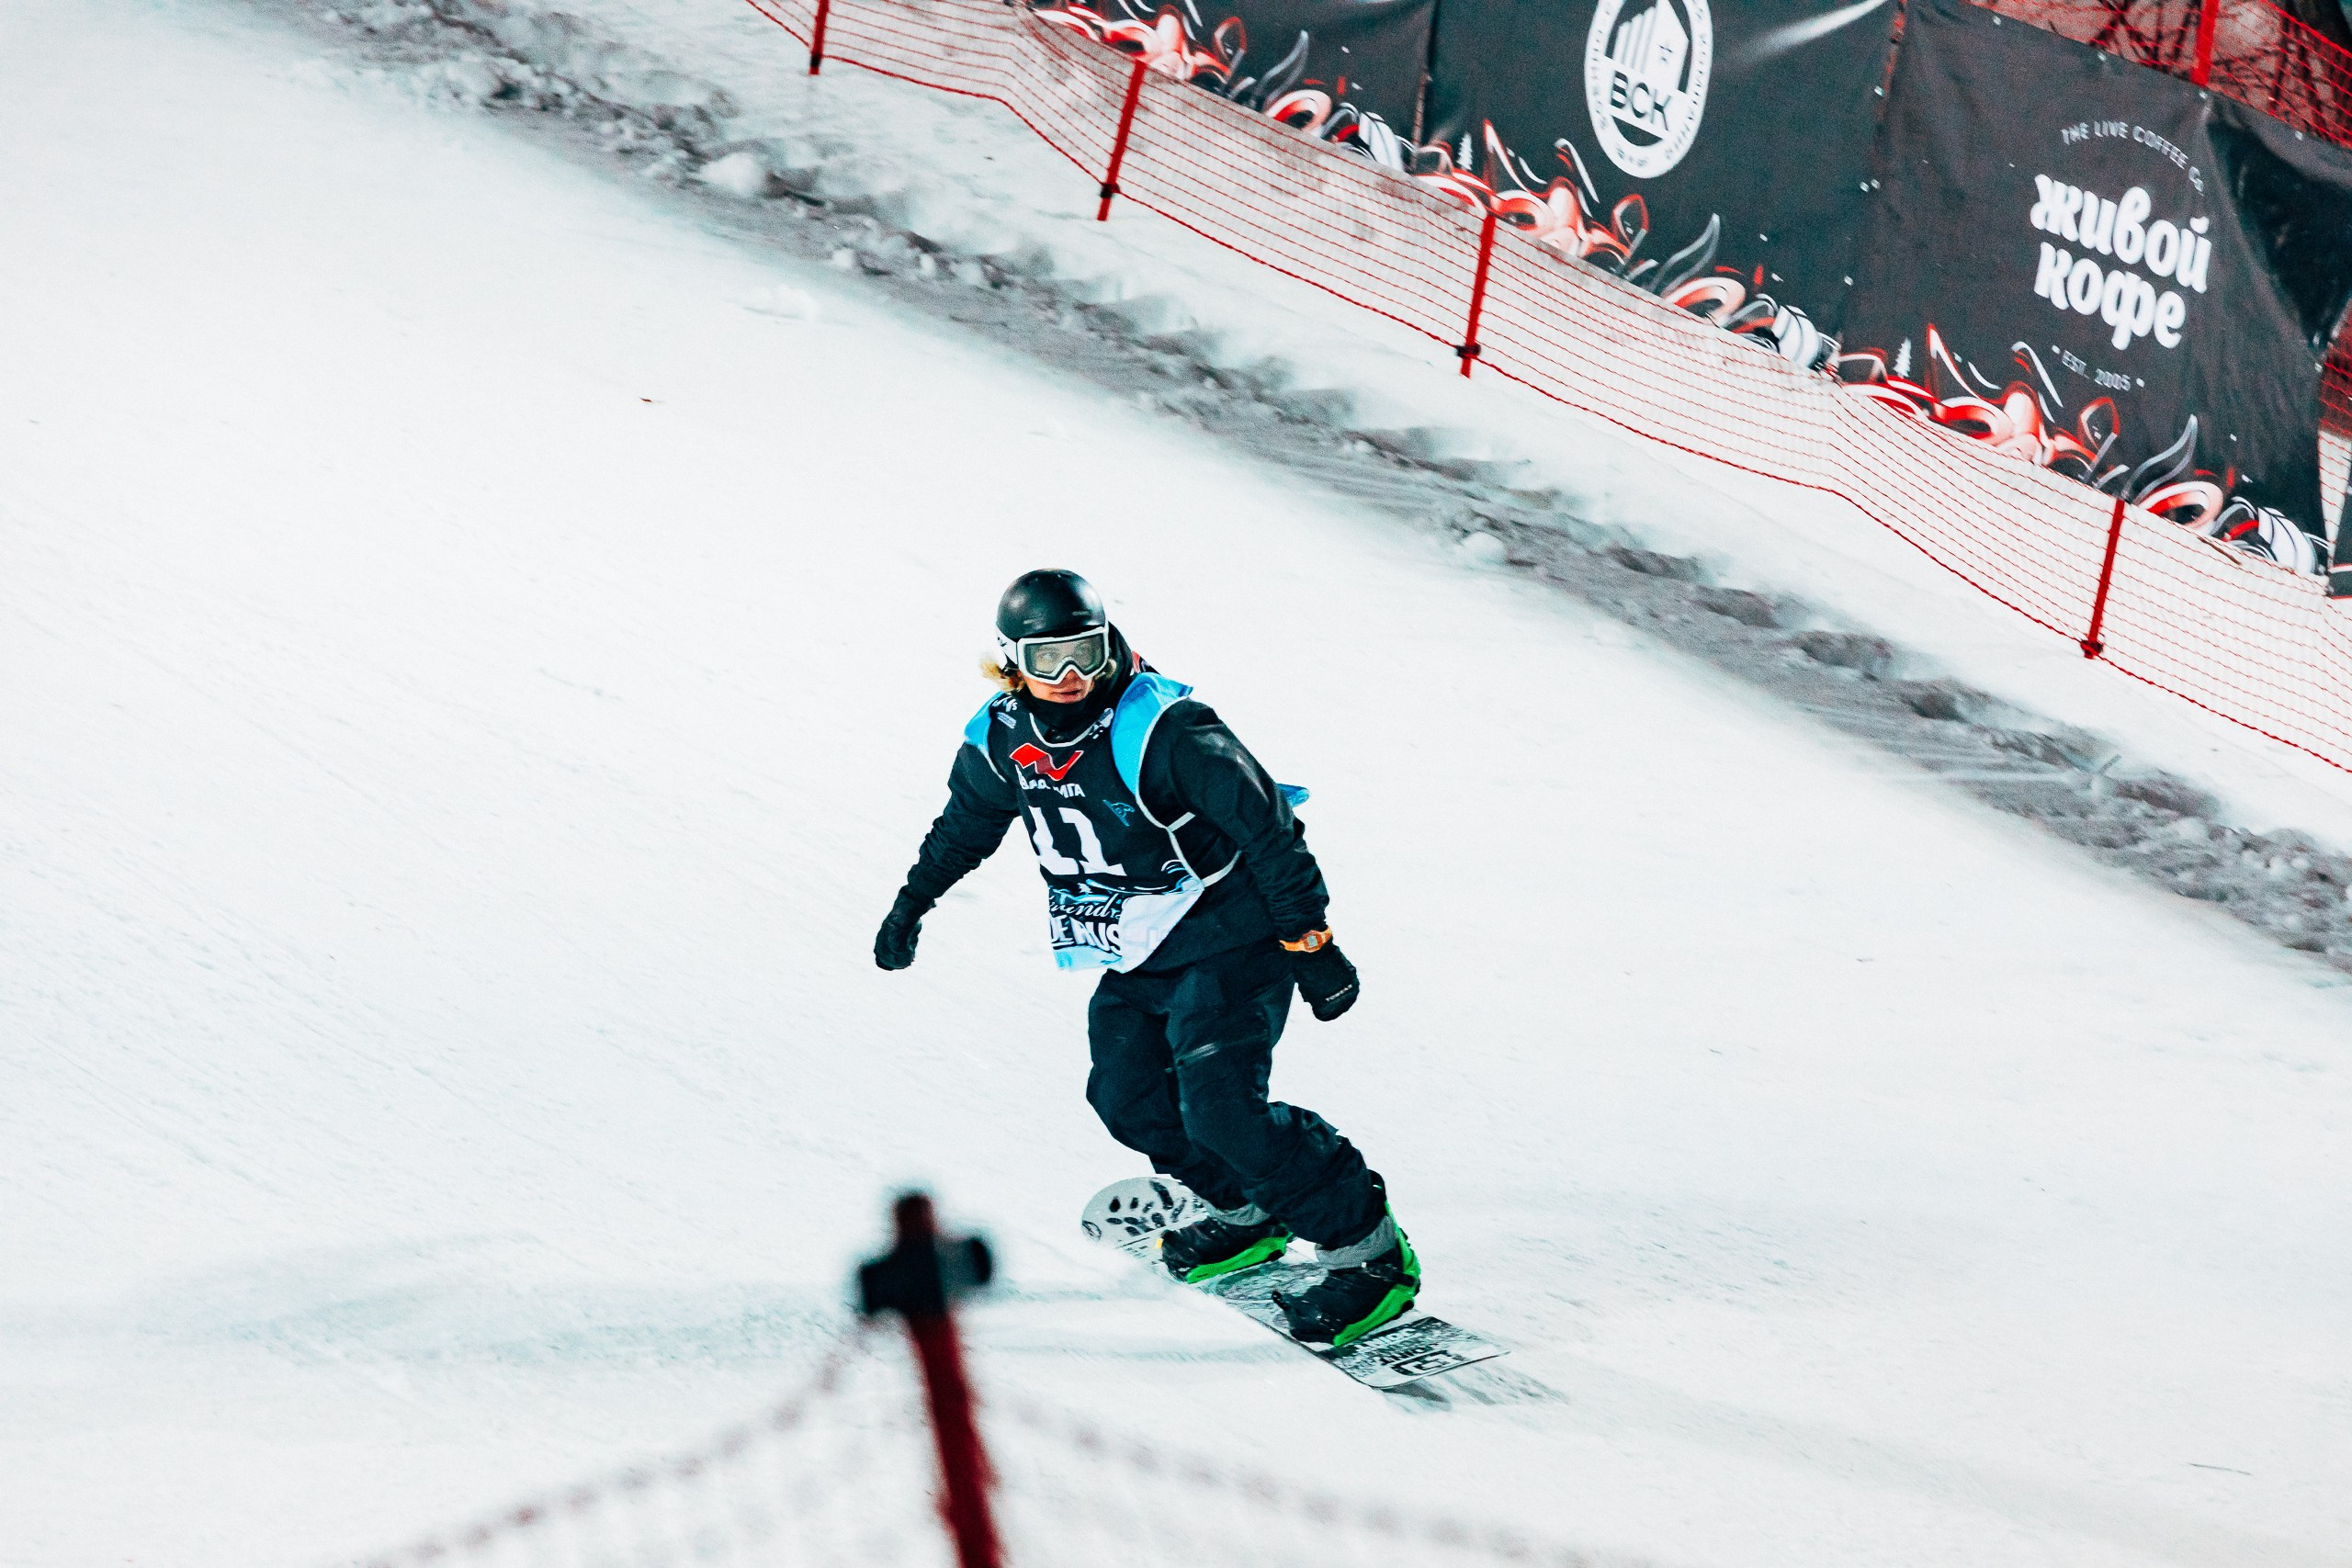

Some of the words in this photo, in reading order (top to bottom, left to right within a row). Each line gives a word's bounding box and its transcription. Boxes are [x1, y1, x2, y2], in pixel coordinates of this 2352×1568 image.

[2094, 120, 2129, 139] LIVE
[2132, 125, 2188, 170] COFFEE
[2030, 173, 2212, 294] живой
[2033, 242, 2187, 351] кофе
[1027, 805, 1127, 876] 11
